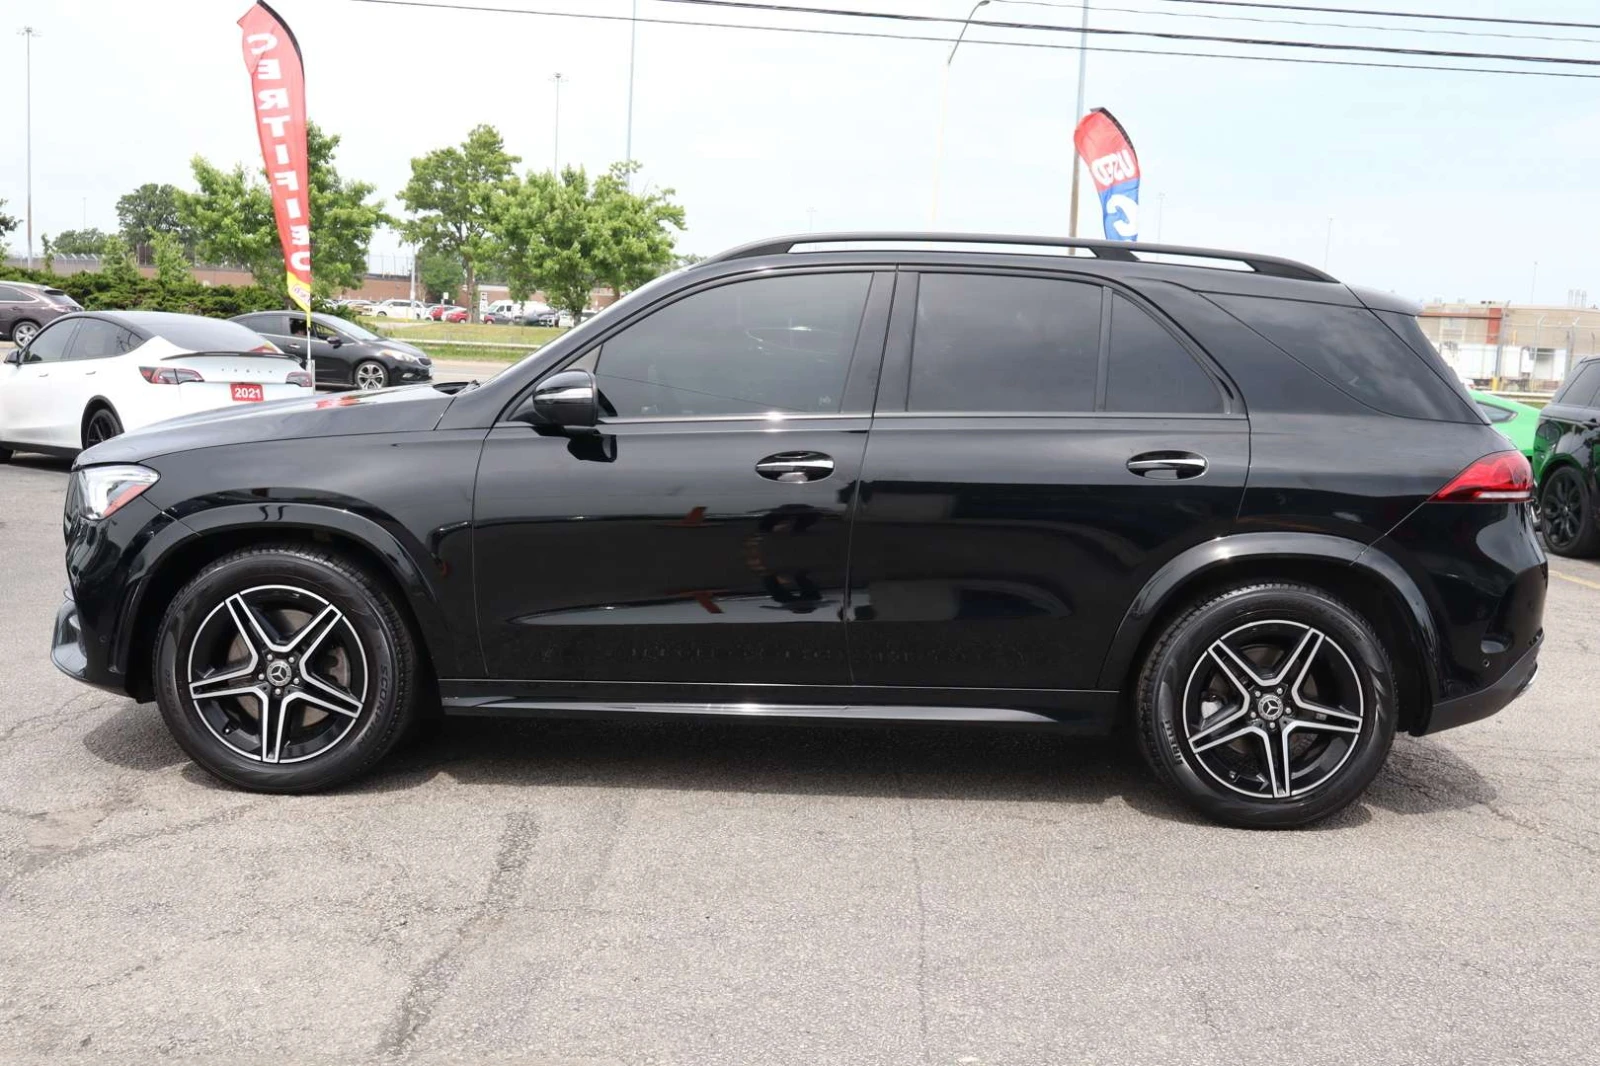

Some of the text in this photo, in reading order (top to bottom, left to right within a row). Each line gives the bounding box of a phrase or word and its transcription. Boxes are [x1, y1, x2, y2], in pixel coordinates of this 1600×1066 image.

[234, 387, 261, 399] 2021
[357, 664, 391, 749] SCORPION
[1160, 720, 1184, 766] PIRELLI
